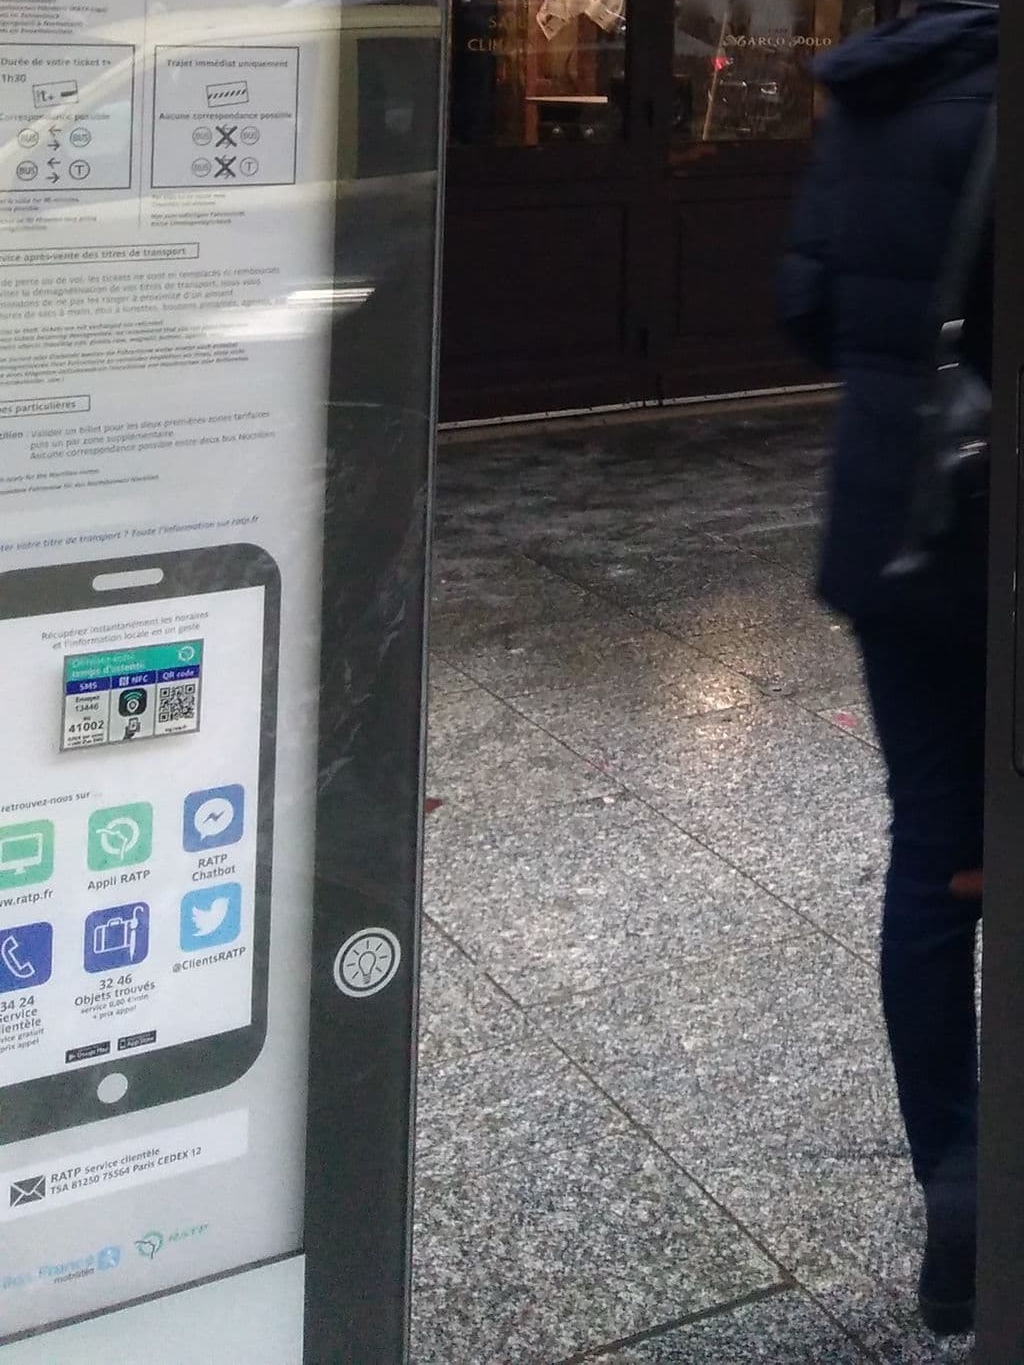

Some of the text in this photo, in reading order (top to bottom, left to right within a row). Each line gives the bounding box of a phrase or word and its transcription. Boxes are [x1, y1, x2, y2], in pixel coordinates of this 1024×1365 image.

[722, 34, 832, 48] MARCO POLO
[32, 58, 42, 66] de
[73, 58, 100, 66] ticket
[167, 59, 289, 69] Trajet immédiat uniquement
[1, 73, 27, 83] 1h30
[193, 113, 258, 121] correspondance
[74, 165, 85, 174] T
[82, 251, 99, 259] des
[129, 249, 140, 257] de
[143, 248, 186, 257] transport
[16, 400, 76, 414] particulières
[80, 425, 101, 434] billet
[164, 417, 206, 428] premières
[30, 451, 63, 460] Aucune
[66, 443, 136, 456] correspondance
[200, 436, 219, 444] deux
[17, 541, 41, 550] votre
[43, 539, 63, 547] titre
[66, 537, 77, 545] de
[79, 531, 122, 544] transport
[131, 528, 156, 537] Toute
[158, 521, 215, 534] l'information
[41, 610, 209, 641] Récupérez instantanément les horaires
[52, 641, 62, 649] et
[64, 633, 123, 648] l'information
[124, 629, 149, 640] locale
[165, 626, 176, 634] un
[178, 623, 200, 634] geste
[162, 672, 174, 680] QR
[176, 669, 195, 678] code
[68, 720, 104, 734] 41002
[1, 792, 90, 813] retrouvez-nous sur
[198, 854, 228, 869] RATP
[87, 876, 117, 891] Appli
[120, 870, 150, 884] RATP
[192, 865, 236, 882] Chatbot
[172, 946, 246, 973] @ClientsRATP
[100, 973, 133, 991] 32 46
[74, 980, 156, 1006] Objets trouvés
[0, 995, 35, 1013] 34 24
[81, 1003, 107, 1014] service
[99, 1010, 114, 1020] prix
[116, 1004, 137, 1015] appel
[17, 1037, 39, 1049] appel
[50, 1147, 161, 1184] RATP Service clientèle
[50, 1146, 202, 1195] TSA 81250 75564 Paris CEDEX 12
